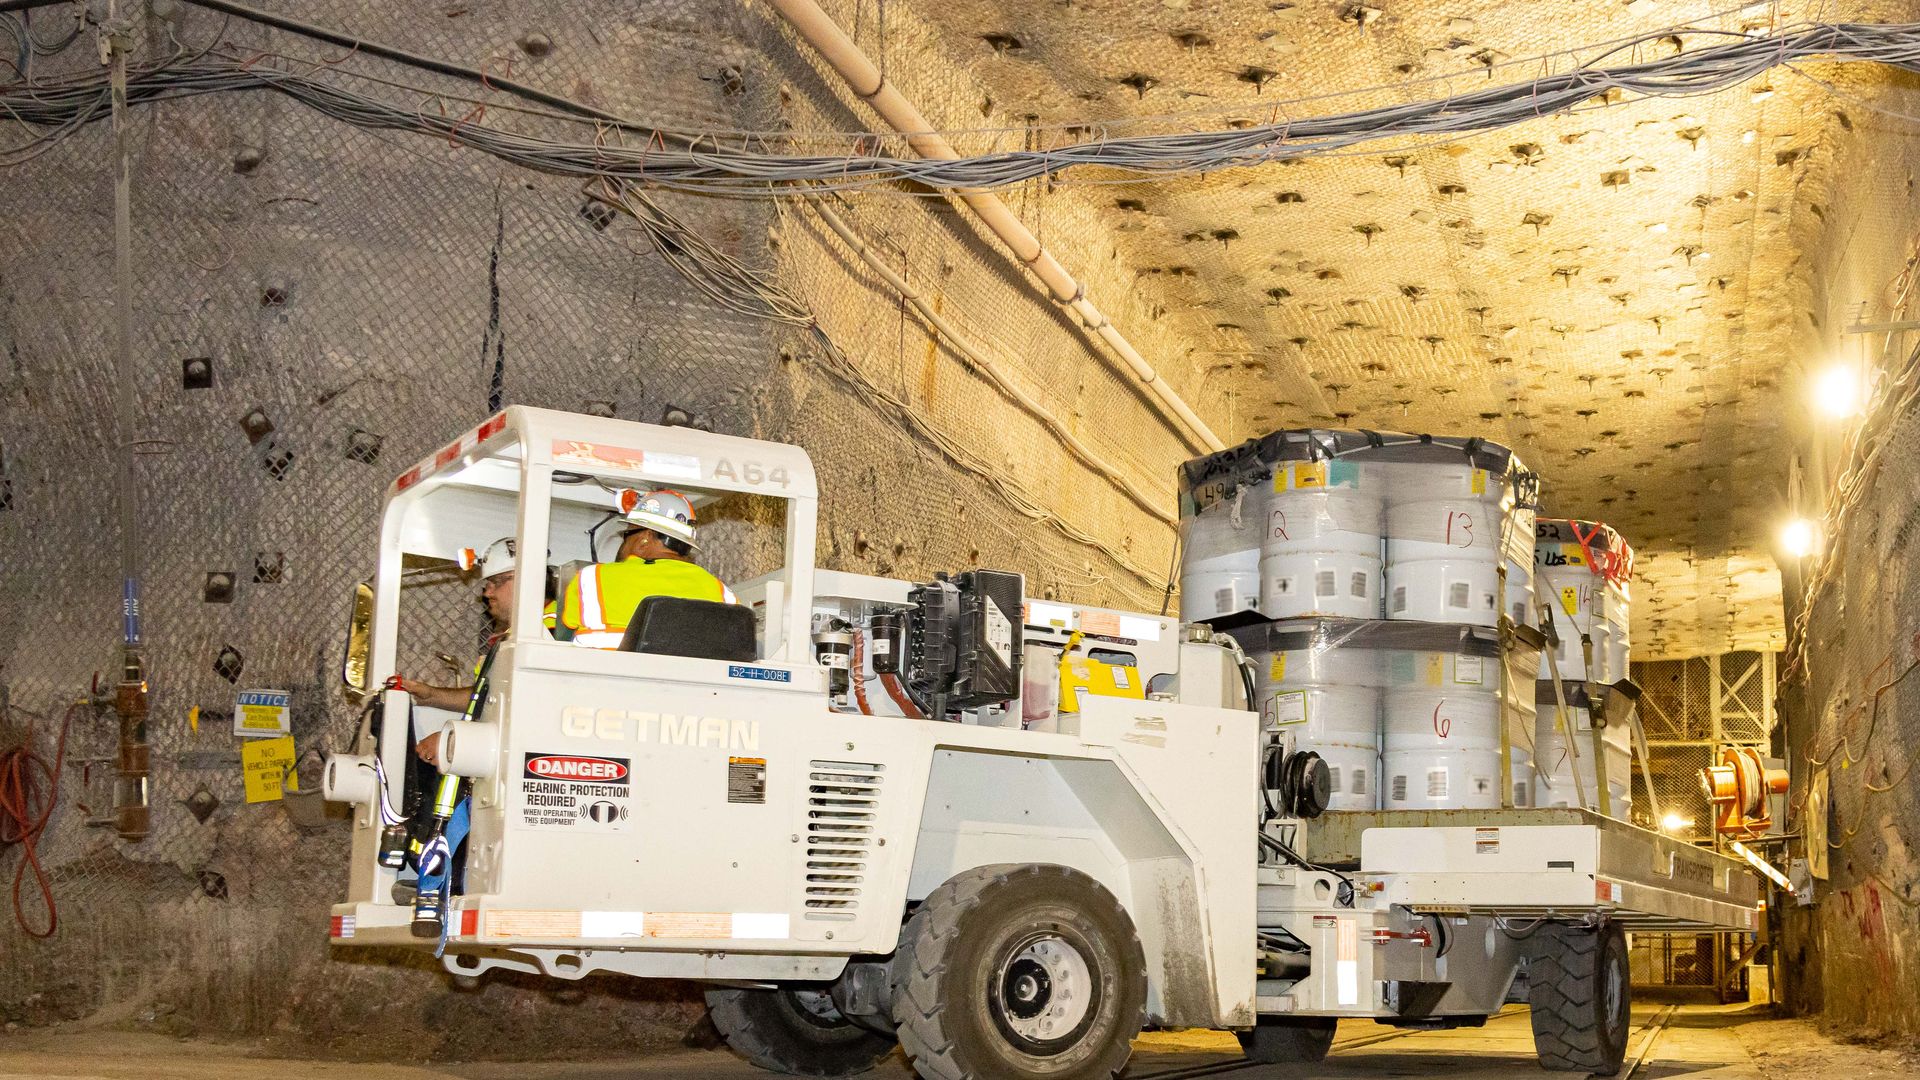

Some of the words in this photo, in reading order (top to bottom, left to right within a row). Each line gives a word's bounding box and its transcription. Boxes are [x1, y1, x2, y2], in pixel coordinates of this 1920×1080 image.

[712, 457, 791, 489] A64
[1266, 510, 1289, 541] 12
[1446, 511, 1474, 549] 13
[239, 693, 289, 705] NOTICE
[1264, 696, 1275, 726] 5
[1433, 700, 1451, 738] 6
[561, 705, 760, 750] GETMAN
[261, 748, 275, 758] NO
[247, 760, 268, 770] VEHICLE
[537, 759, 618, 778] DANGER
[522, 781, 567, 795] HEARING
[569, 784, 629, 798] PROTECTION
[527, 794, 576, 808] REQUIRED
[523, 808, 541, 816] WHEN
[543, 809, 578, 818] OPERATING
[524, 816, 539, 824] THIS
[540, 817, 576, 826] EQUIPMENT
